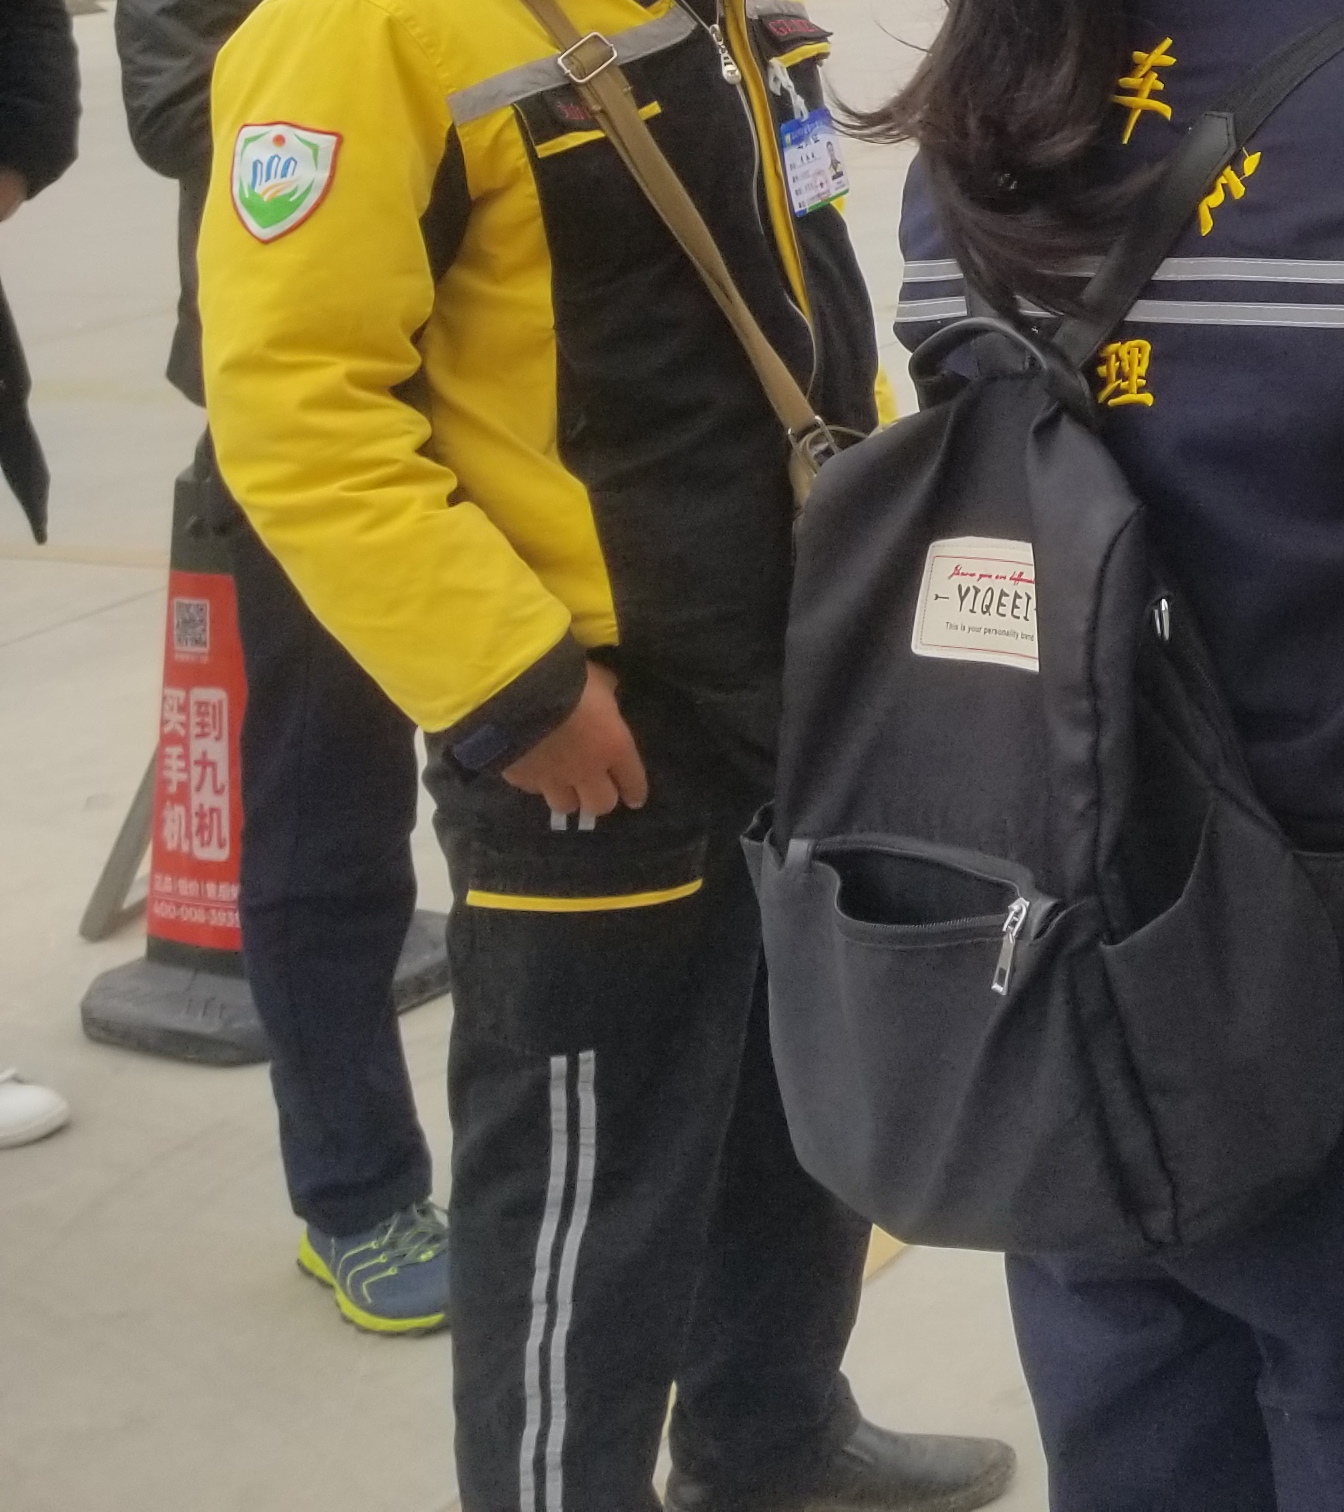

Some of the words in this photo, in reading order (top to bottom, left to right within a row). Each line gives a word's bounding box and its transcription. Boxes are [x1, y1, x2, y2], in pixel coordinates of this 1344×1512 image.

[946, 621, 959, 631] This
[967, 626, 982, 634] your
[983, 626, 1020, 640] personality
[162, 688, 190, 854] 买手机
[193, 699, 227, 850] 到九机
